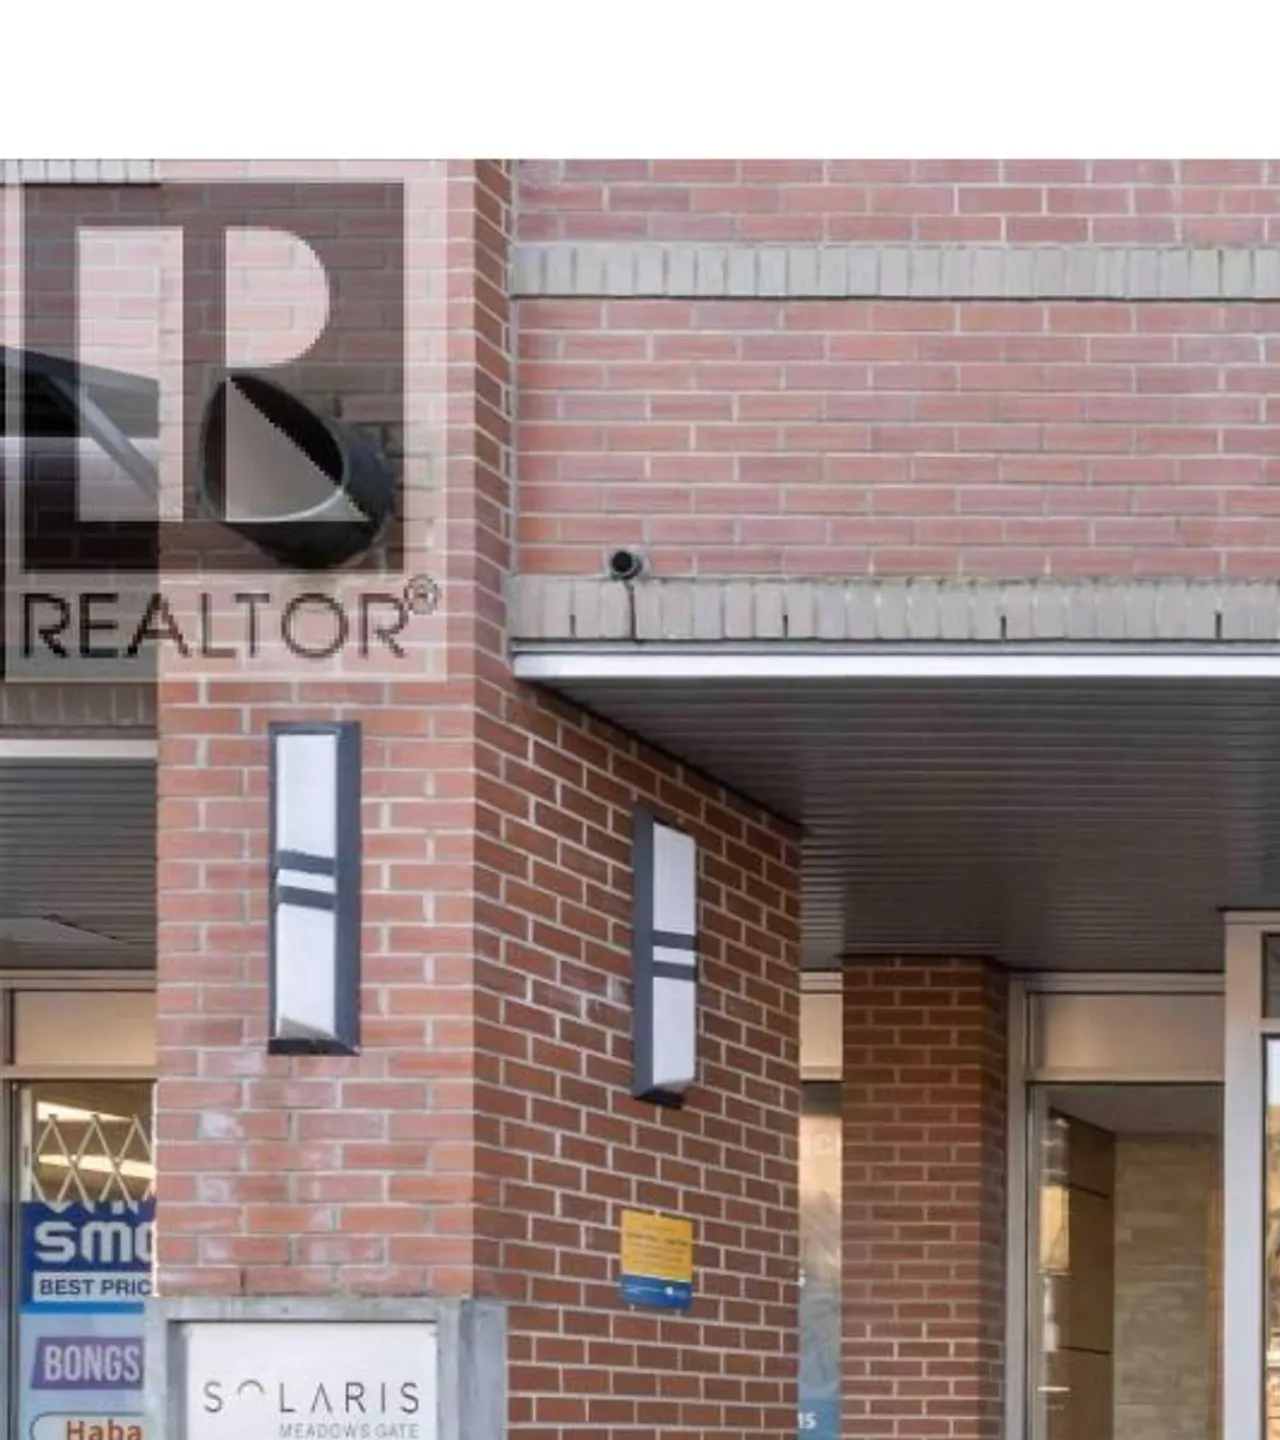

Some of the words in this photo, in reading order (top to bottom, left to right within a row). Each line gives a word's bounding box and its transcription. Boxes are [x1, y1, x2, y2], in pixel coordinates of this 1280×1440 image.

[40, 1279, 95, 1296] BEST
[44, 1344, 141, 1382] BONGS
[278, 1423, 369, 1439] MEADOWS
[374, 1423, 419, 1439] GATE
